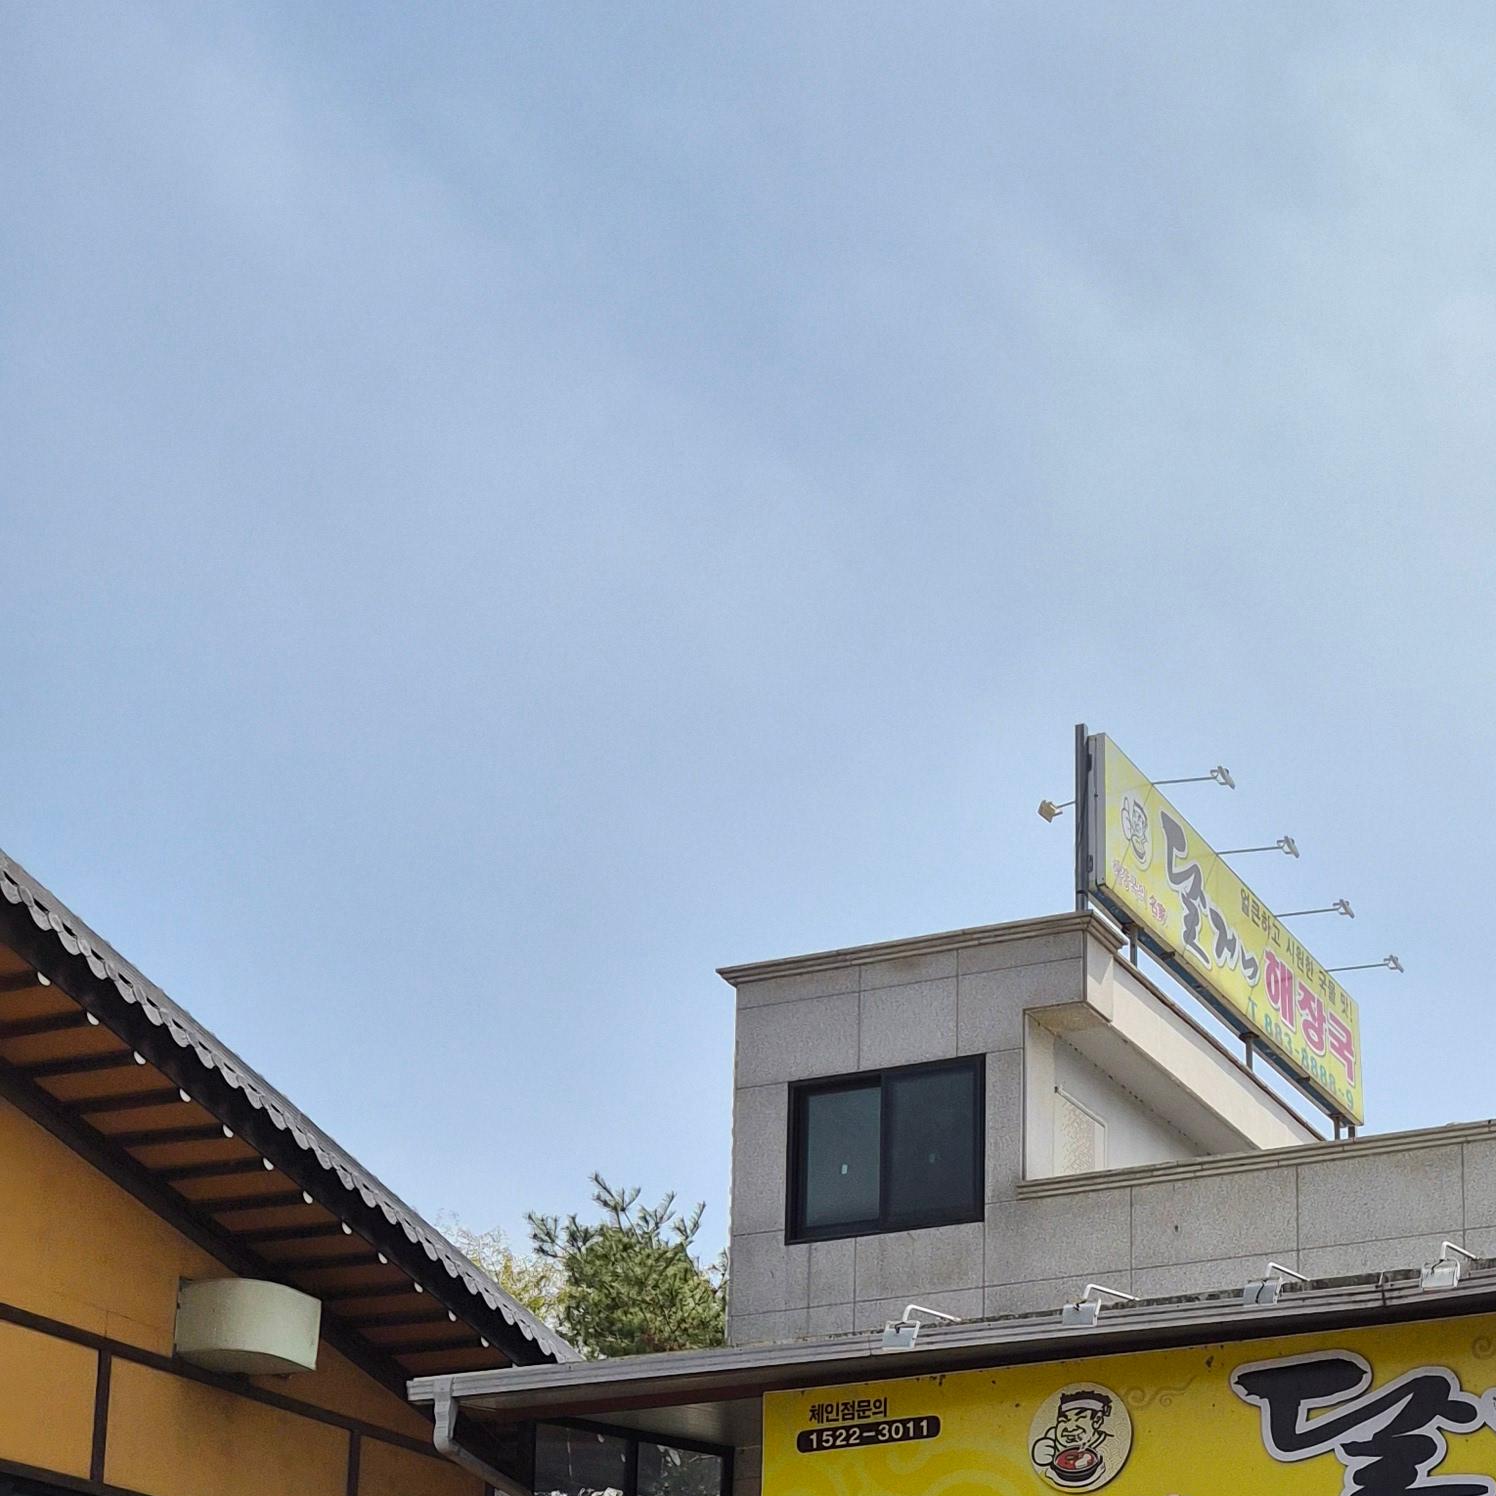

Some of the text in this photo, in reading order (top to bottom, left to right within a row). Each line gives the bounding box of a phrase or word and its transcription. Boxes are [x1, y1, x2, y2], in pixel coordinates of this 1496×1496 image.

[1240, 888, 1281, 948] 얼큰하고
[1286, 942, 1314, 982] 시원한
[1318, 970, 1337, 1005] 국물
[1264, 948, 1355, 1087] 해장국
[808, 1398, 888, 1424] 체인점문의
[808, 1419, 930, 1450] 1522-3011
